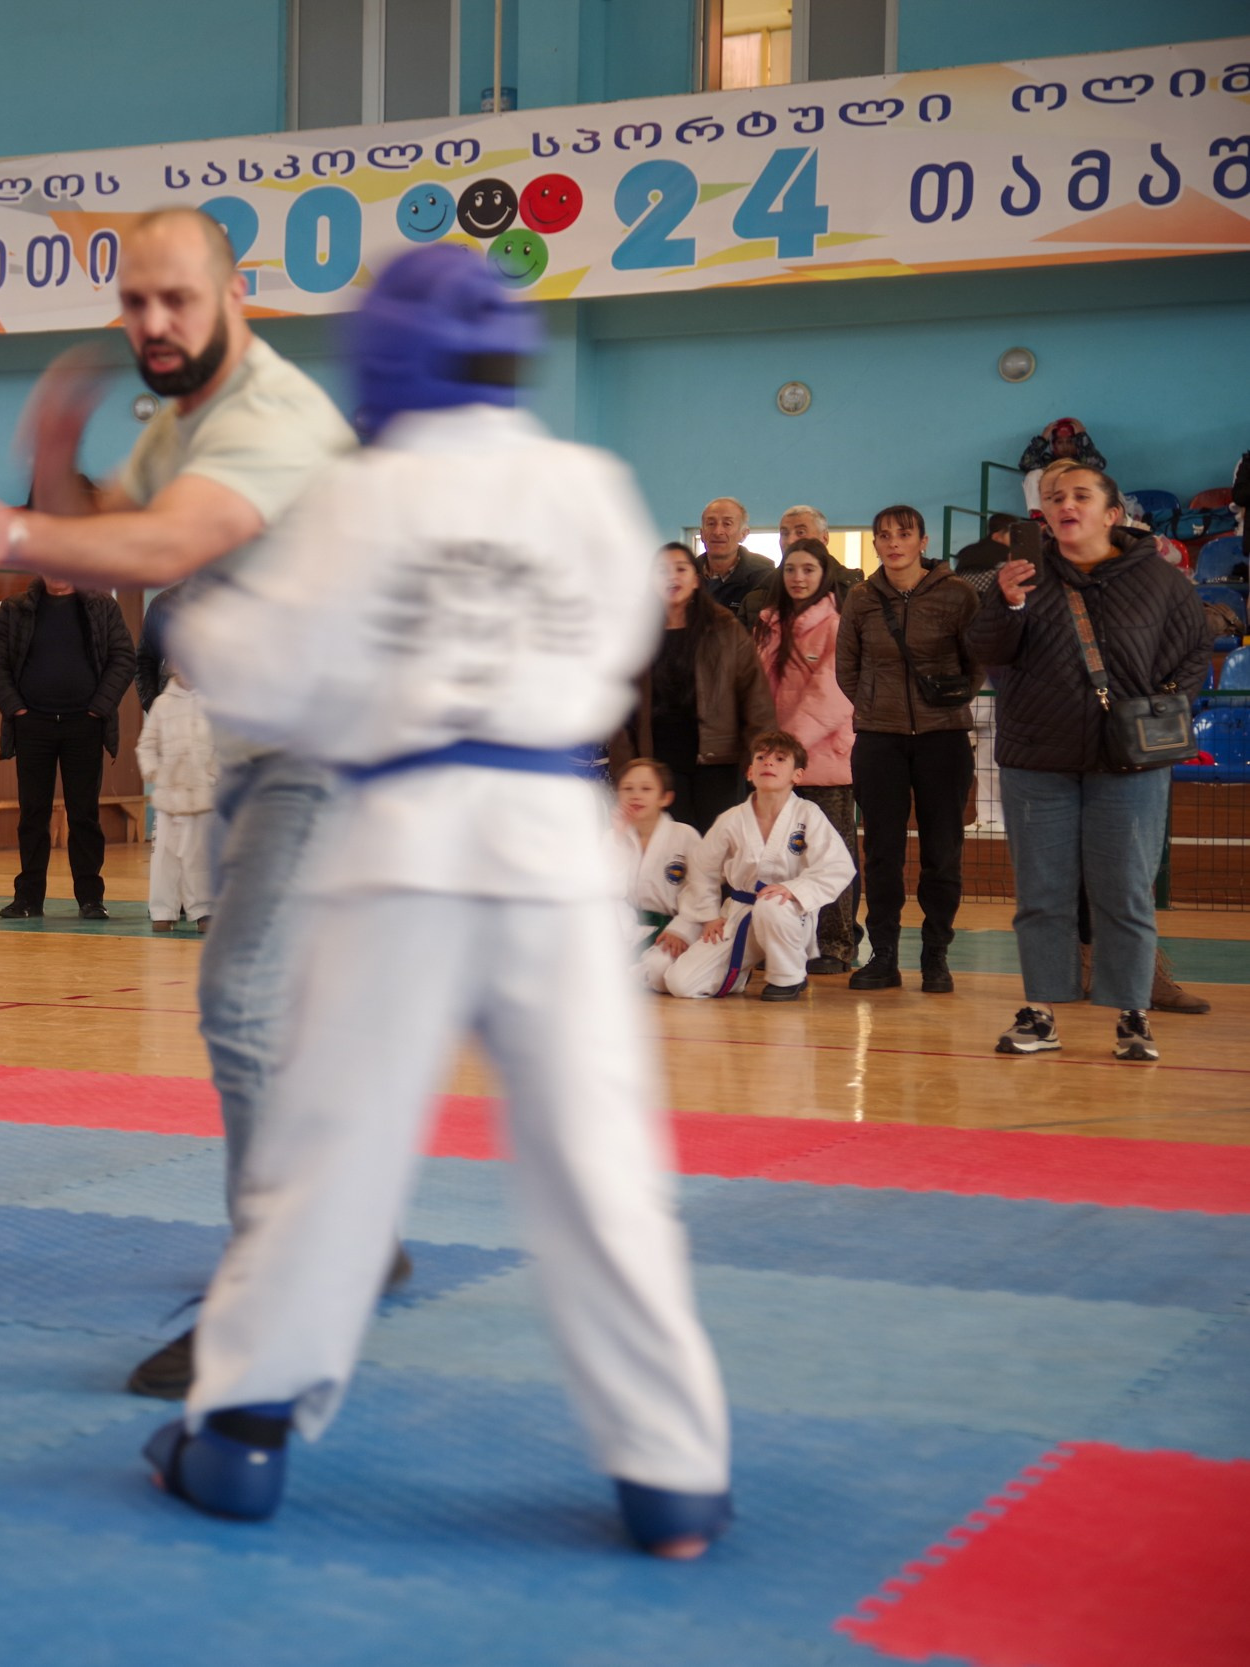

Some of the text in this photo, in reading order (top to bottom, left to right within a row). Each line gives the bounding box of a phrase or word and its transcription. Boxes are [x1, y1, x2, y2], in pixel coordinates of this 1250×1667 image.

[164, 138, 481, 189] სასკოლო
[532, 93, 952, 158] სპორტული
[611, 146, 830, 271] 24
